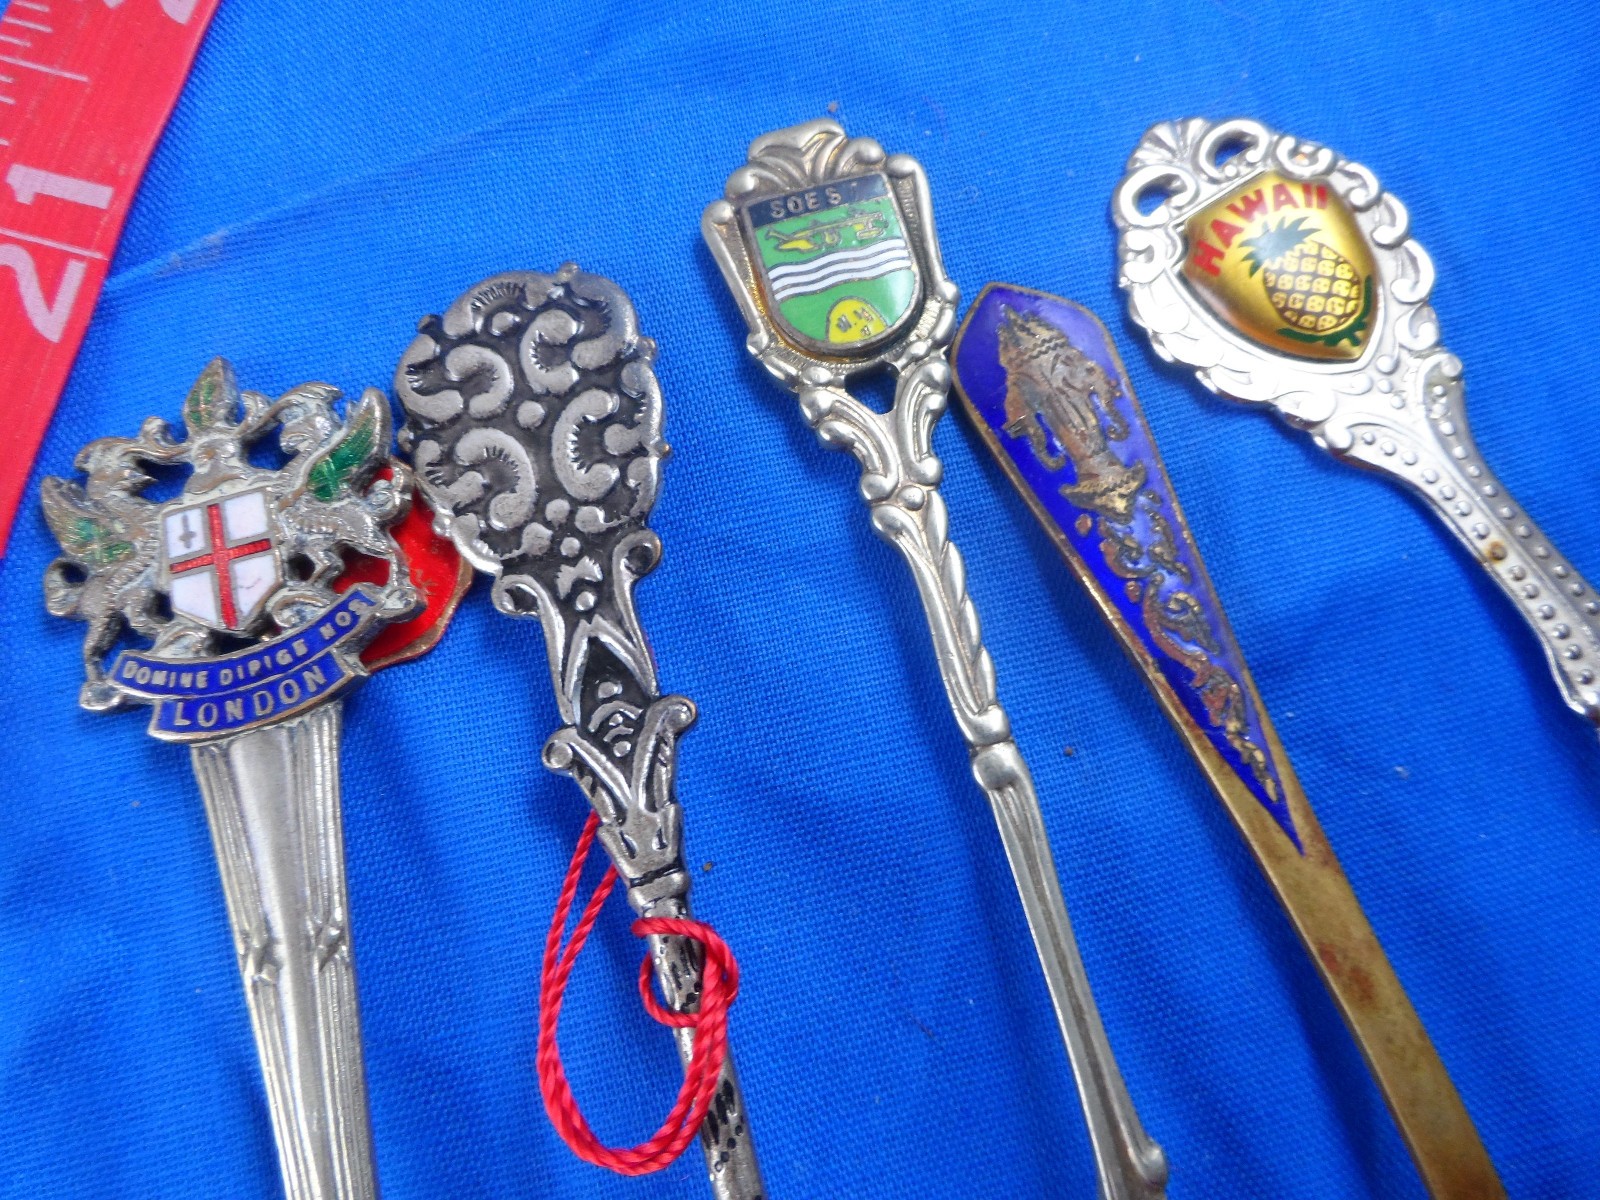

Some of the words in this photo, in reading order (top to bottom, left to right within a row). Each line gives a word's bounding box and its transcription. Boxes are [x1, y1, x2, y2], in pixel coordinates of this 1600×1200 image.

[1194, 183, 1328, 278] HAWAII
[122, 660, 208, 689] DOMINE
[174, 665, 327, 728] LONDON
